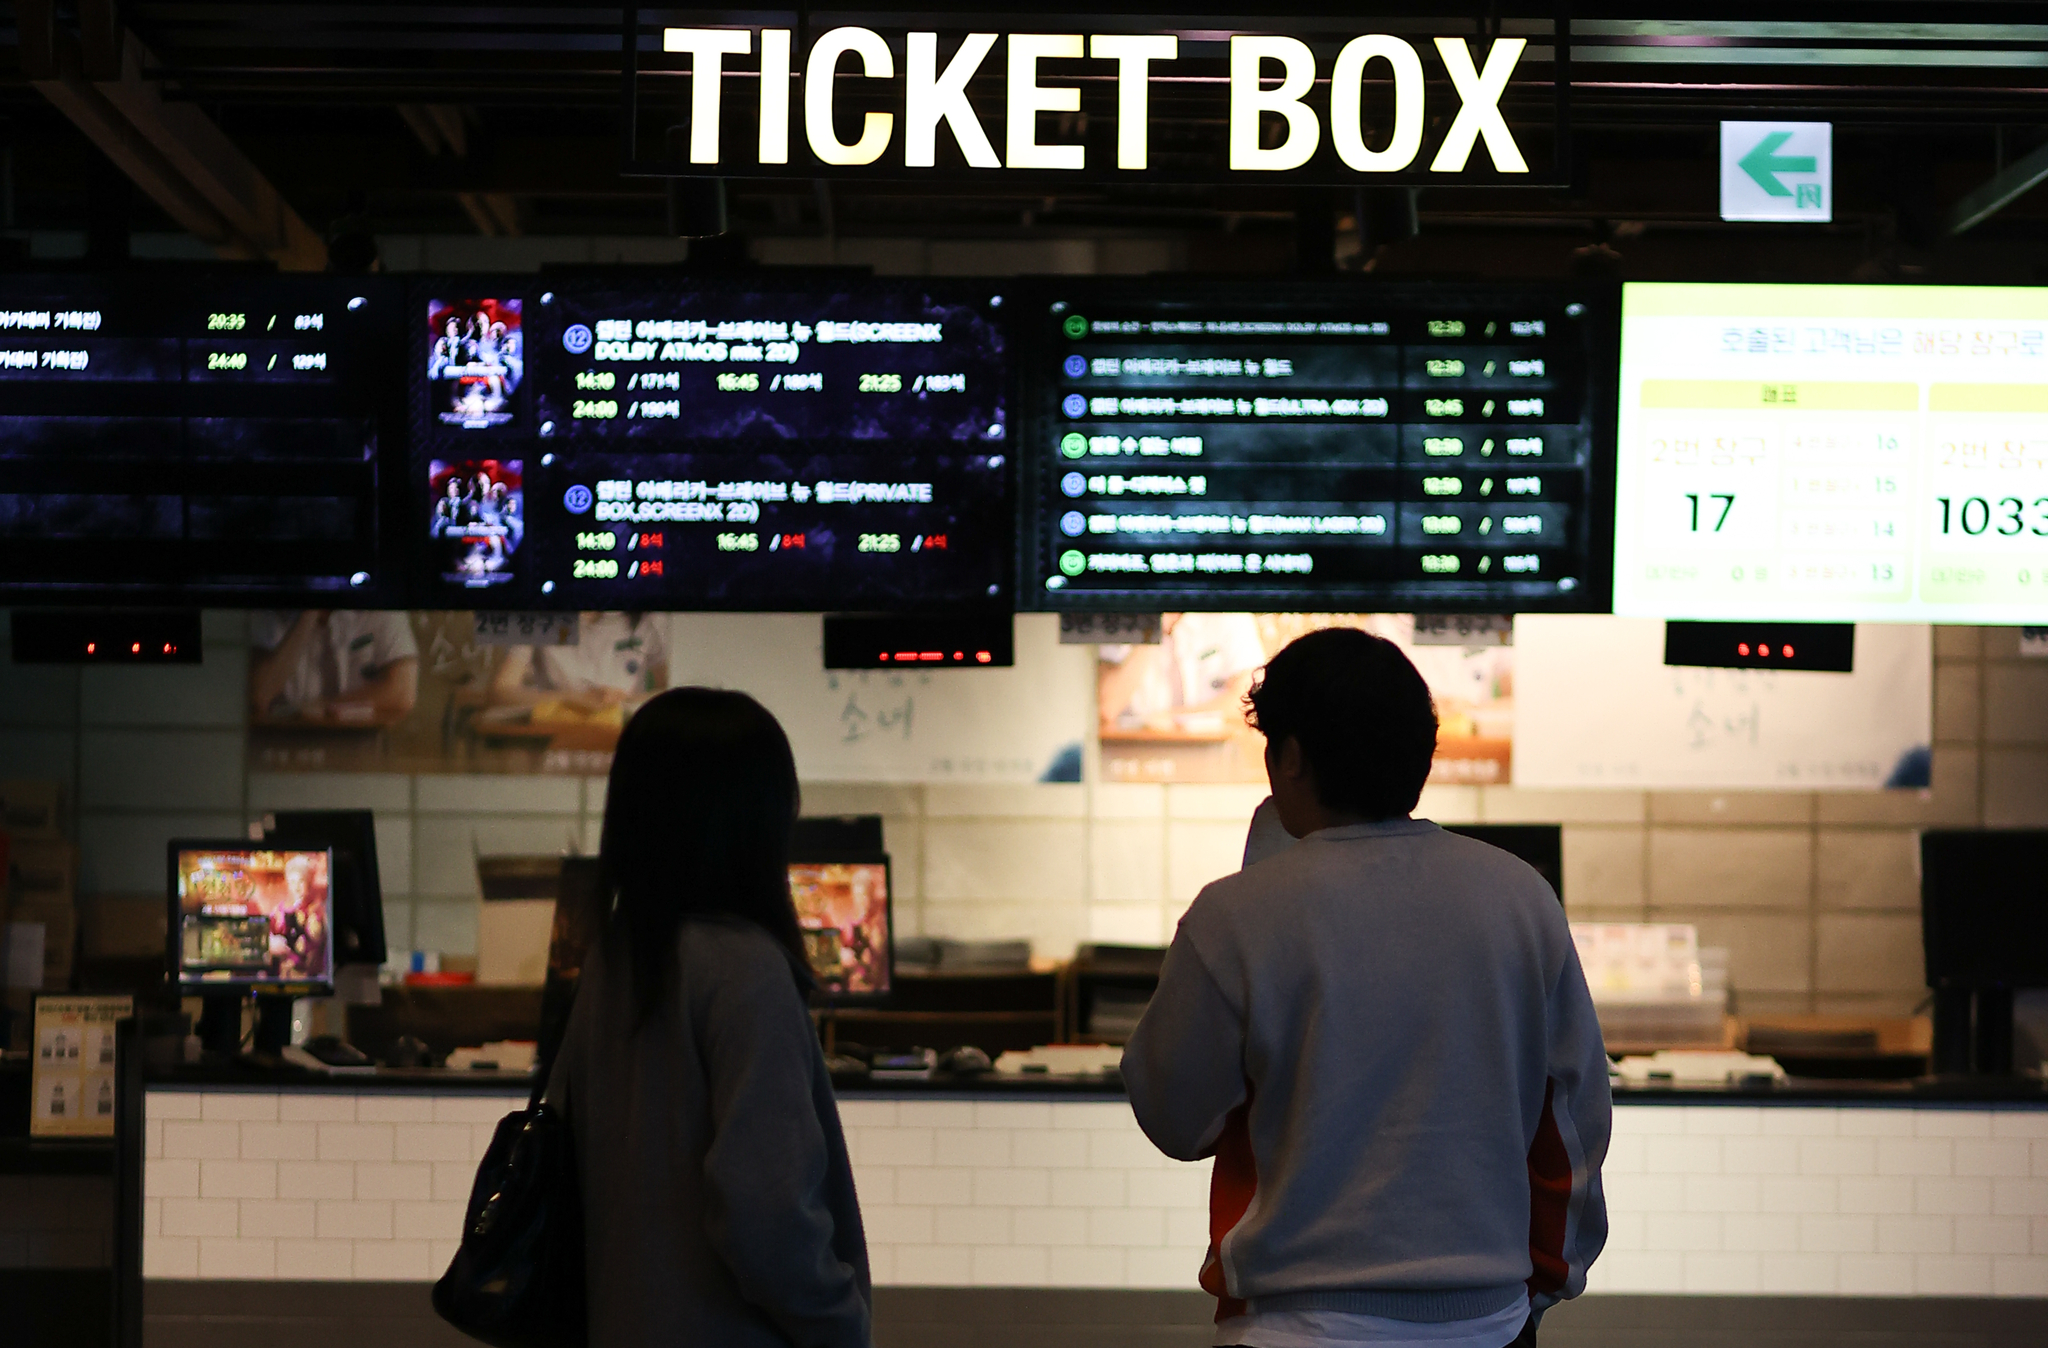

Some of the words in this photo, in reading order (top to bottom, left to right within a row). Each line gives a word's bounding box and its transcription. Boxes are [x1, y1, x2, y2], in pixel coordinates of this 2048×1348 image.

[663, 27, 1179, 171] TICKET
[1229, 34, 1530, 173] BOX
[1721, 327, 1796, 354] 호출된
[1803, 327, 1903, 355] 고객님은
[660, 343, 729, 363] ATMOS
[1877, 433, 1899, 451] 16
[1875, 476, 1897, 493] 15
[1684, 492, 1737, 533] 17
[1873, 520, 1895, 538] 14
[1871, 563, 1894, 581] 13
